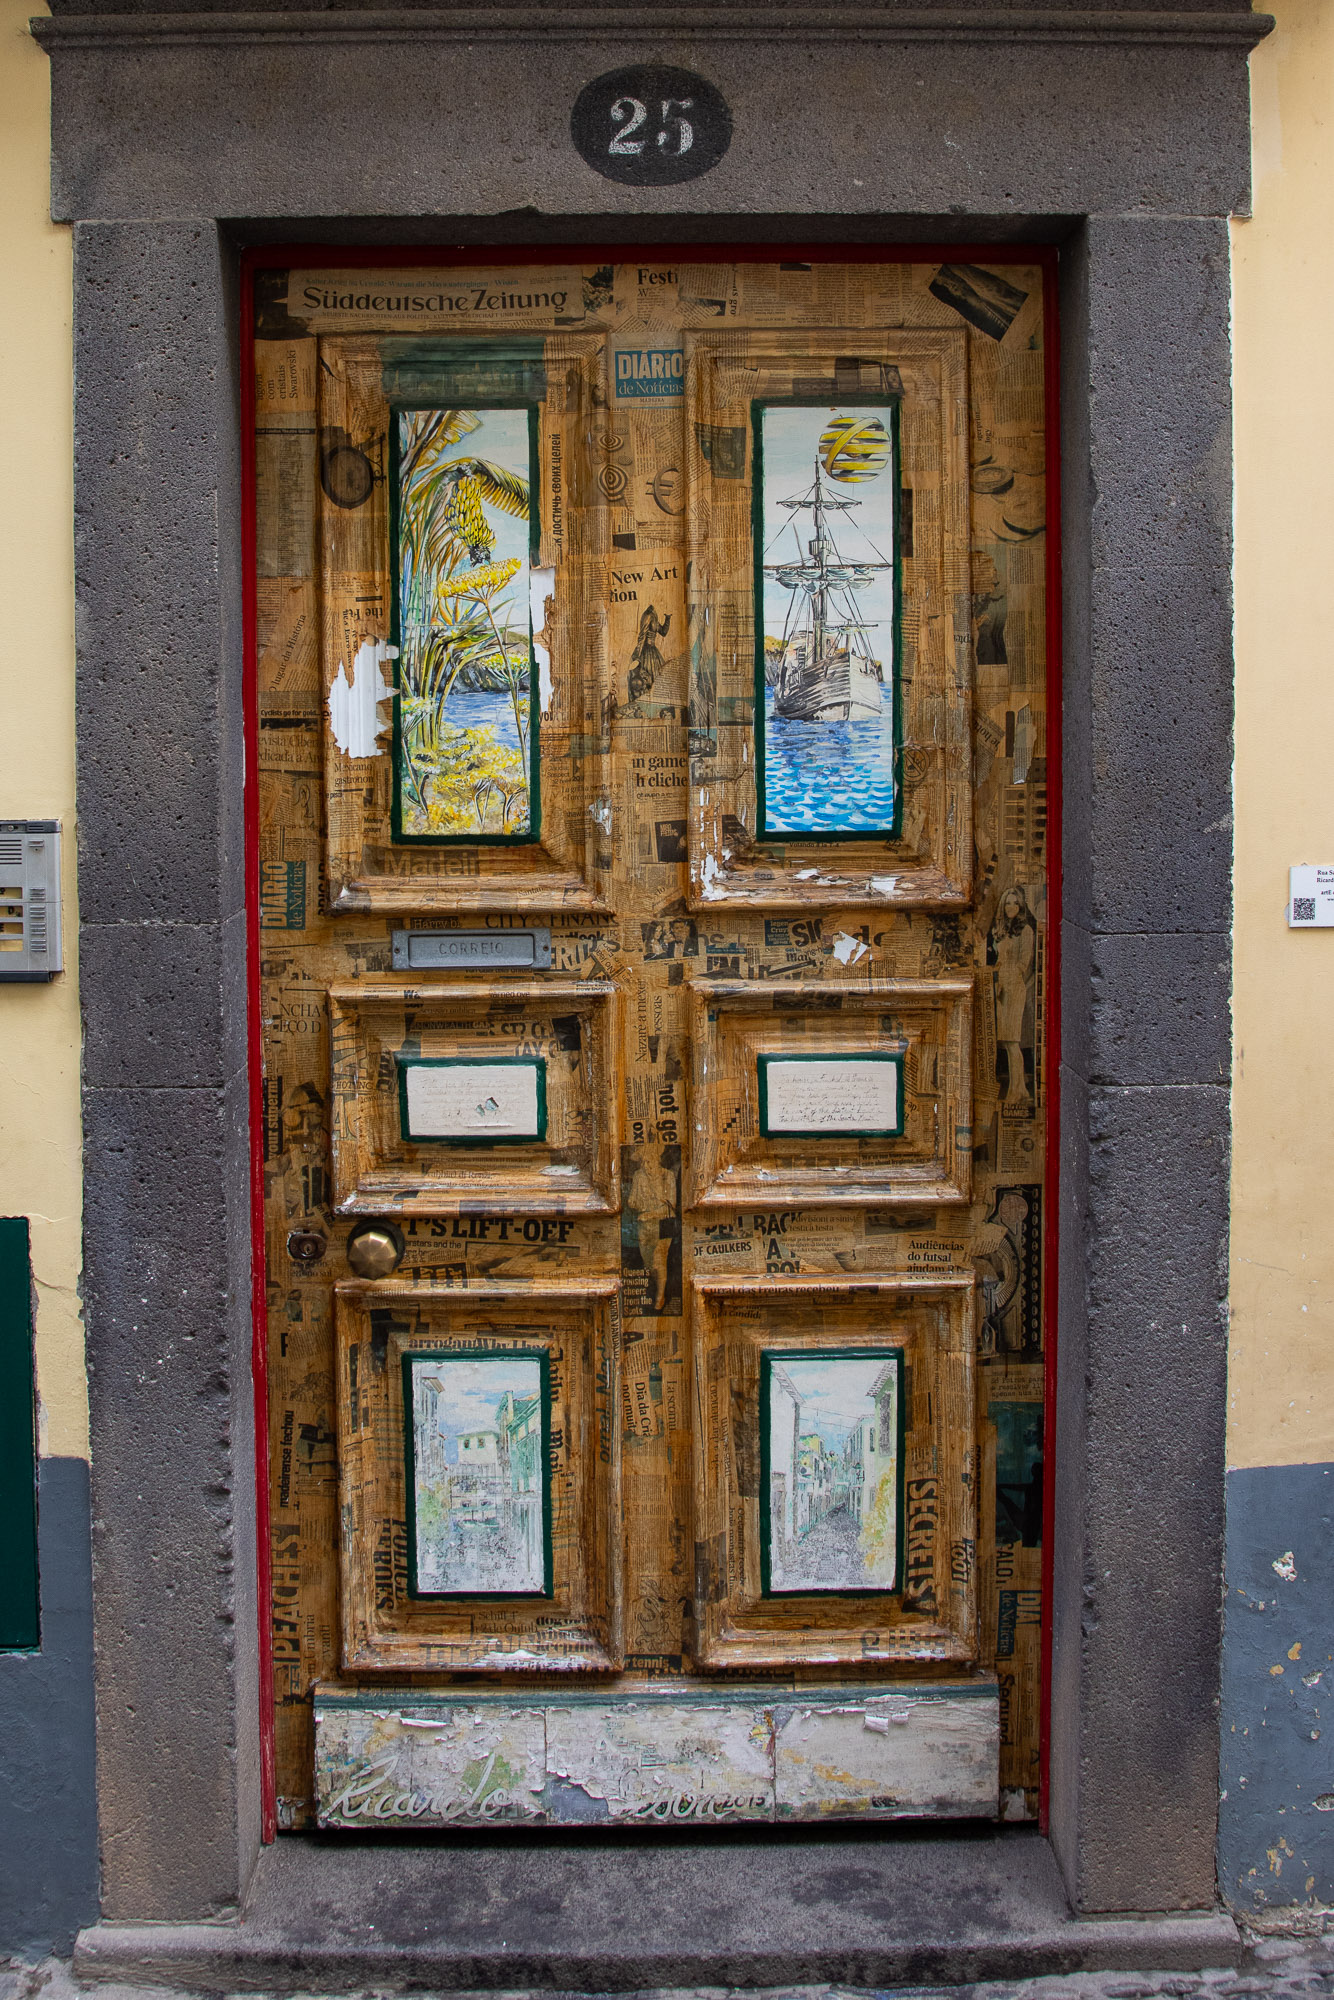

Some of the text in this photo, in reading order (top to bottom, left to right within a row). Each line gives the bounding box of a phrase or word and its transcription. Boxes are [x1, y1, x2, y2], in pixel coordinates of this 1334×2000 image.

[608, 97, 694, 156] 25
[303, 286, 568, 313] Süddeutsche Zeitung
[276, 364, 286, 400] cristais
[286, 350, 298, 399] Swarovski
[267, 379, 275, 400] com
[618, 380, 685, 395] de Notícias
[548, 433, 564, 536] достичь своих целей
[611, 564, 679, 586] New Art
[285, 614, 307, 650] História
[281, 650, 293, 662] da
[270, 662, 287, 686] lugar
[288, 861, 304, 927] de Notícias
[266, 949, 291, 957] Desporto
[438, 942, 505, 956] CORREIO
[280, 1003, 321, 1018] NCHA
[652, 995, 664, 1036] pessoas
[632, 1024, 648, 1063] Nazaré
[656, 1083, 679, 1144] not ge
[450, 1218, 575, 1243] LIFT-OFF
[433, 1239, 448, 1249] and
[448, 1239, 462, 1249] the
[705, 1241, 753, 1256] CAULKERS
[908, 1239, 965, 1251] Audiências
[907, 1251, 952, 1263] do futsal
[622, 1267, 651, 1278] Queen's
[622, 1276, 650, 1288] rousing
[622, 1287, 648, 1296] cheers
[623, 1295, 653, 1306] from the
[634, 1381, 650, 1416] Dia da
[276, 1410, 295, 1508] madeirense fechou
[907, 1480, 938, 1598] SECRETS
[632, 1656, 670, 1668] tennis
